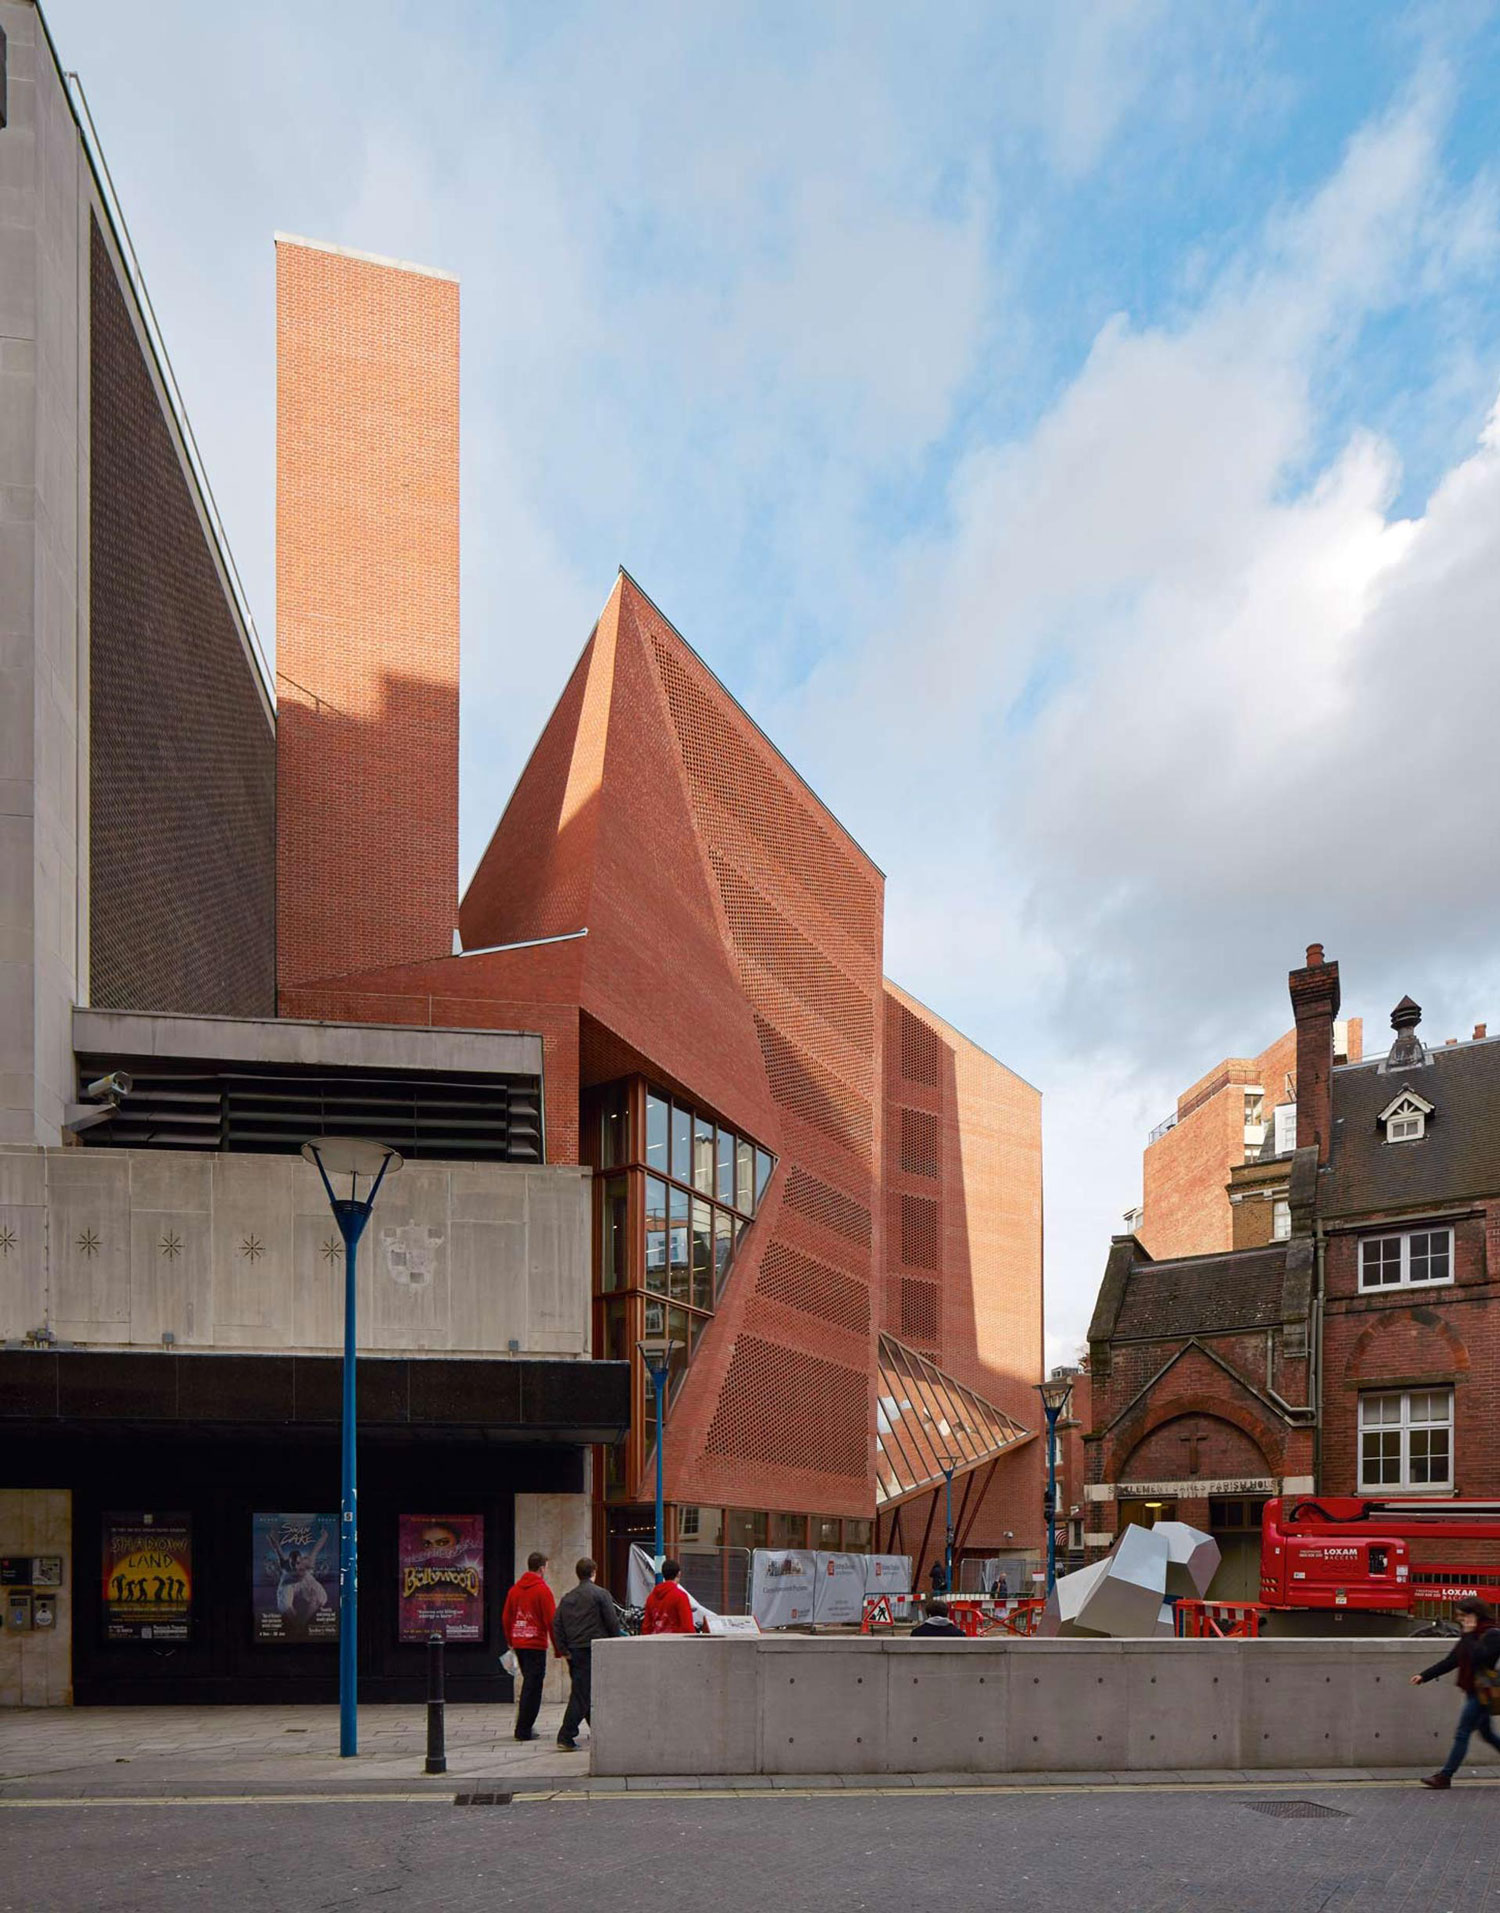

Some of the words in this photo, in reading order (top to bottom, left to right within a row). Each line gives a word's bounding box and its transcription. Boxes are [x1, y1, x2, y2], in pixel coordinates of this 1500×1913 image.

[1210, 1481, 1247, 1491] PARISH
[112, 1536, 188, 1552] SHADOW
[128, 1552, 174, 1568] LAND
[1442, 1589, 1477, 1597] LOXAM
